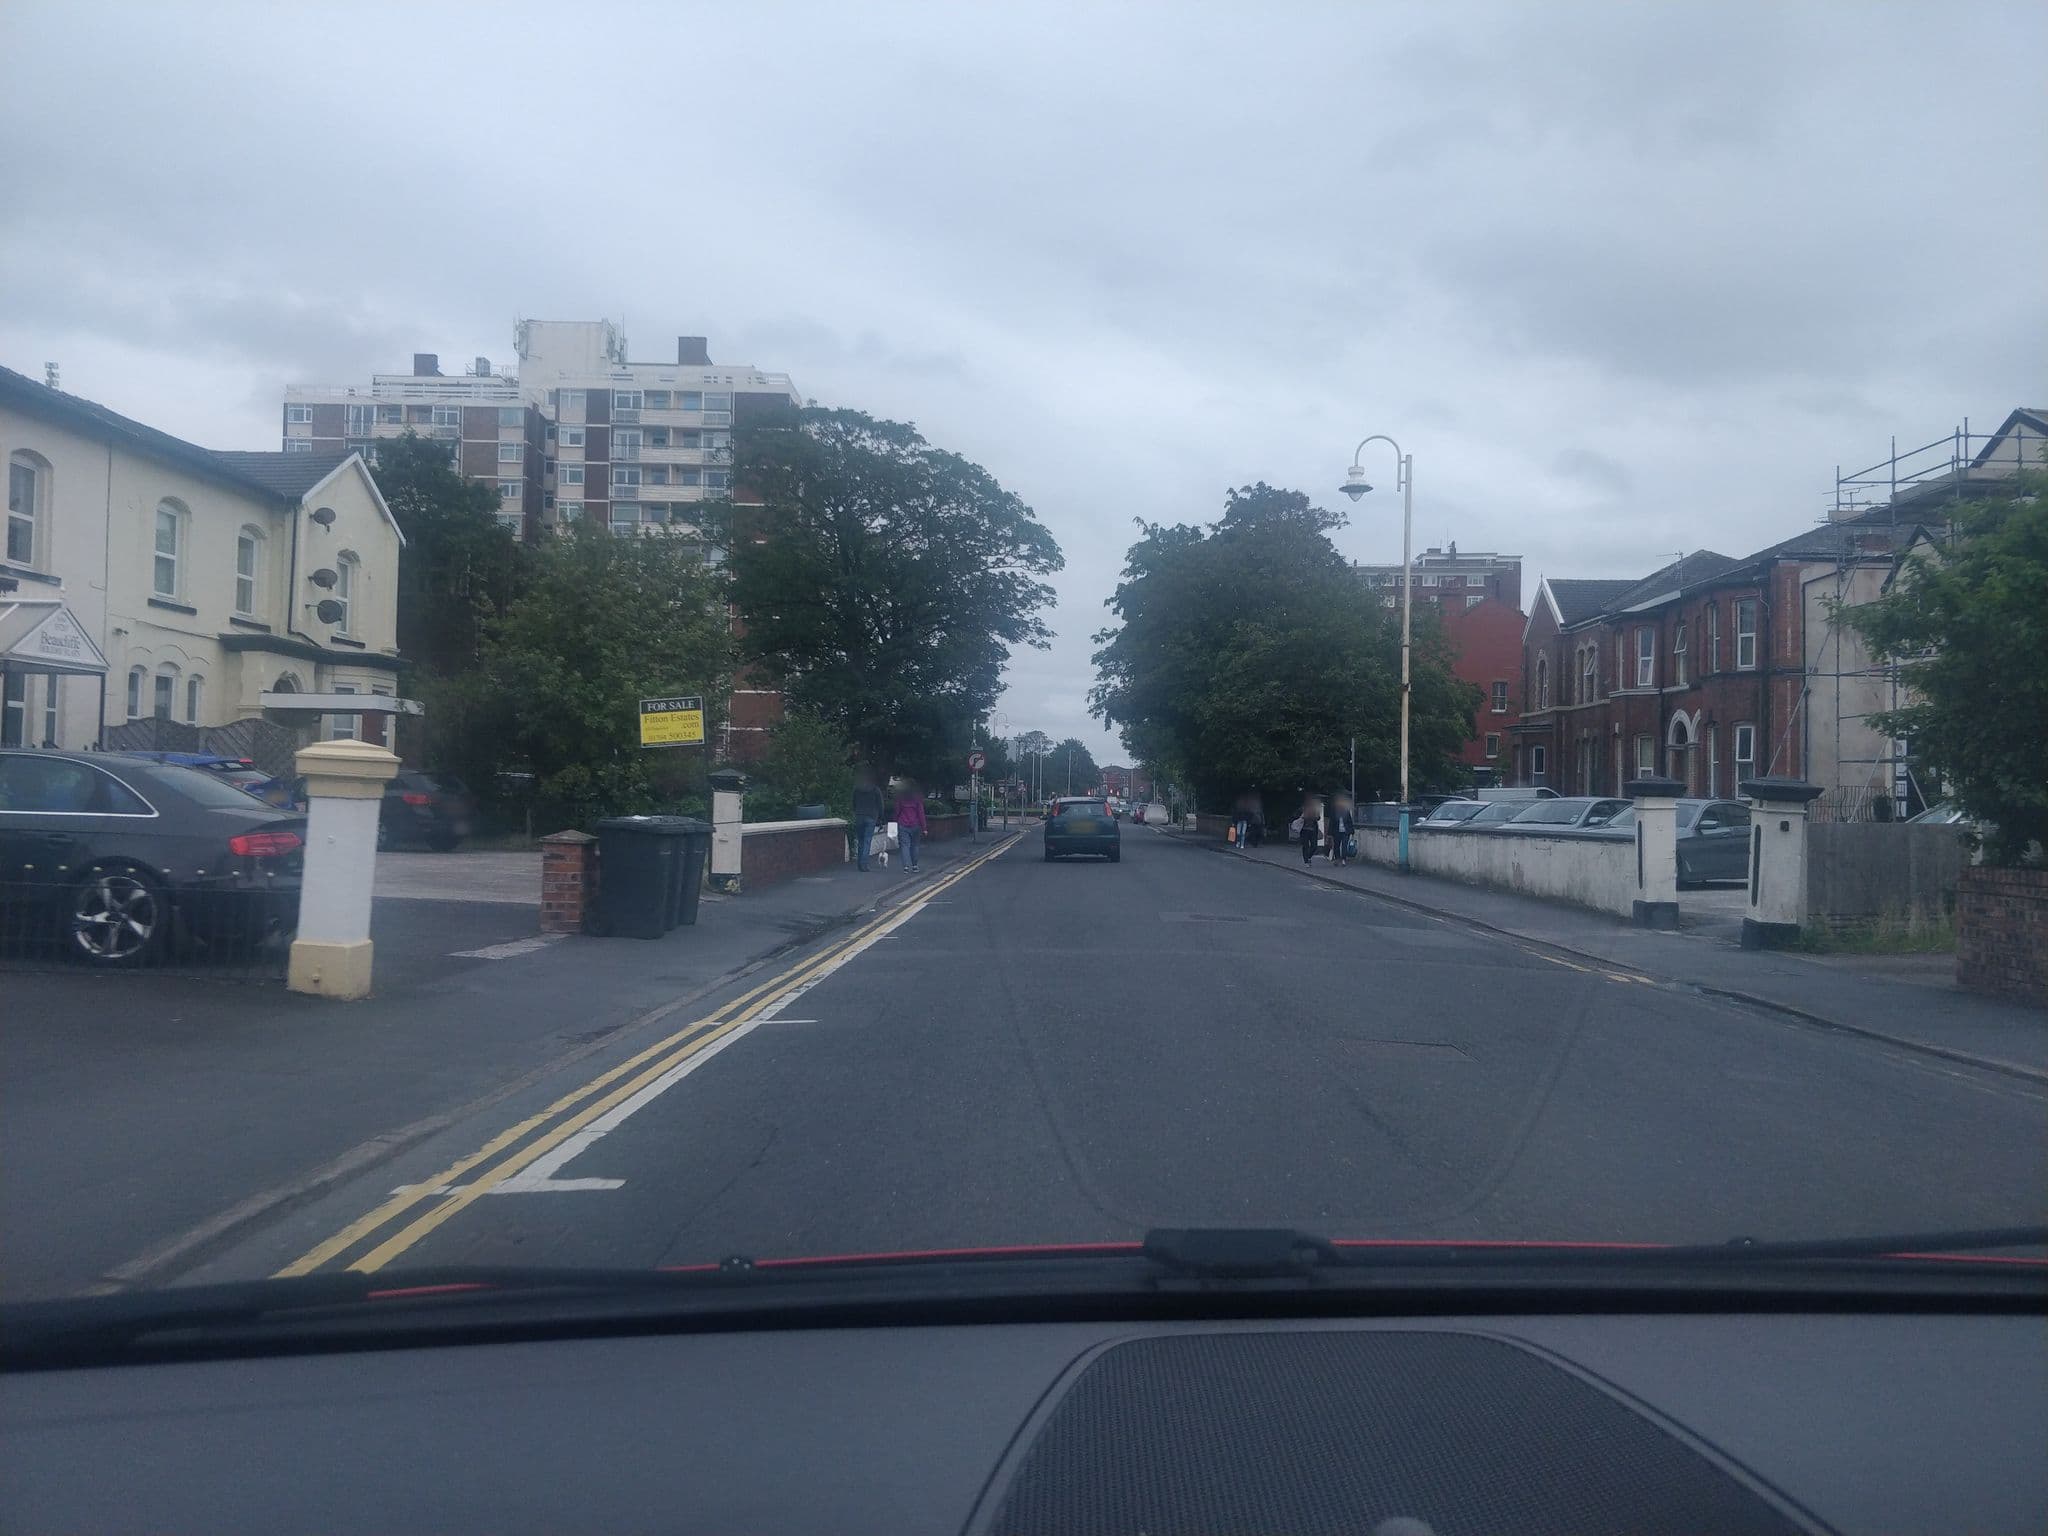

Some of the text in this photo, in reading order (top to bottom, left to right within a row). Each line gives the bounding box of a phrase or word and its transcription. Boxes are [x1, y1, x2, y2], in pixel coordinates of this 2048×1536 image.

[648, 701, 695, 711] FOR SALE
[671, 713, 700, 721] Estates
